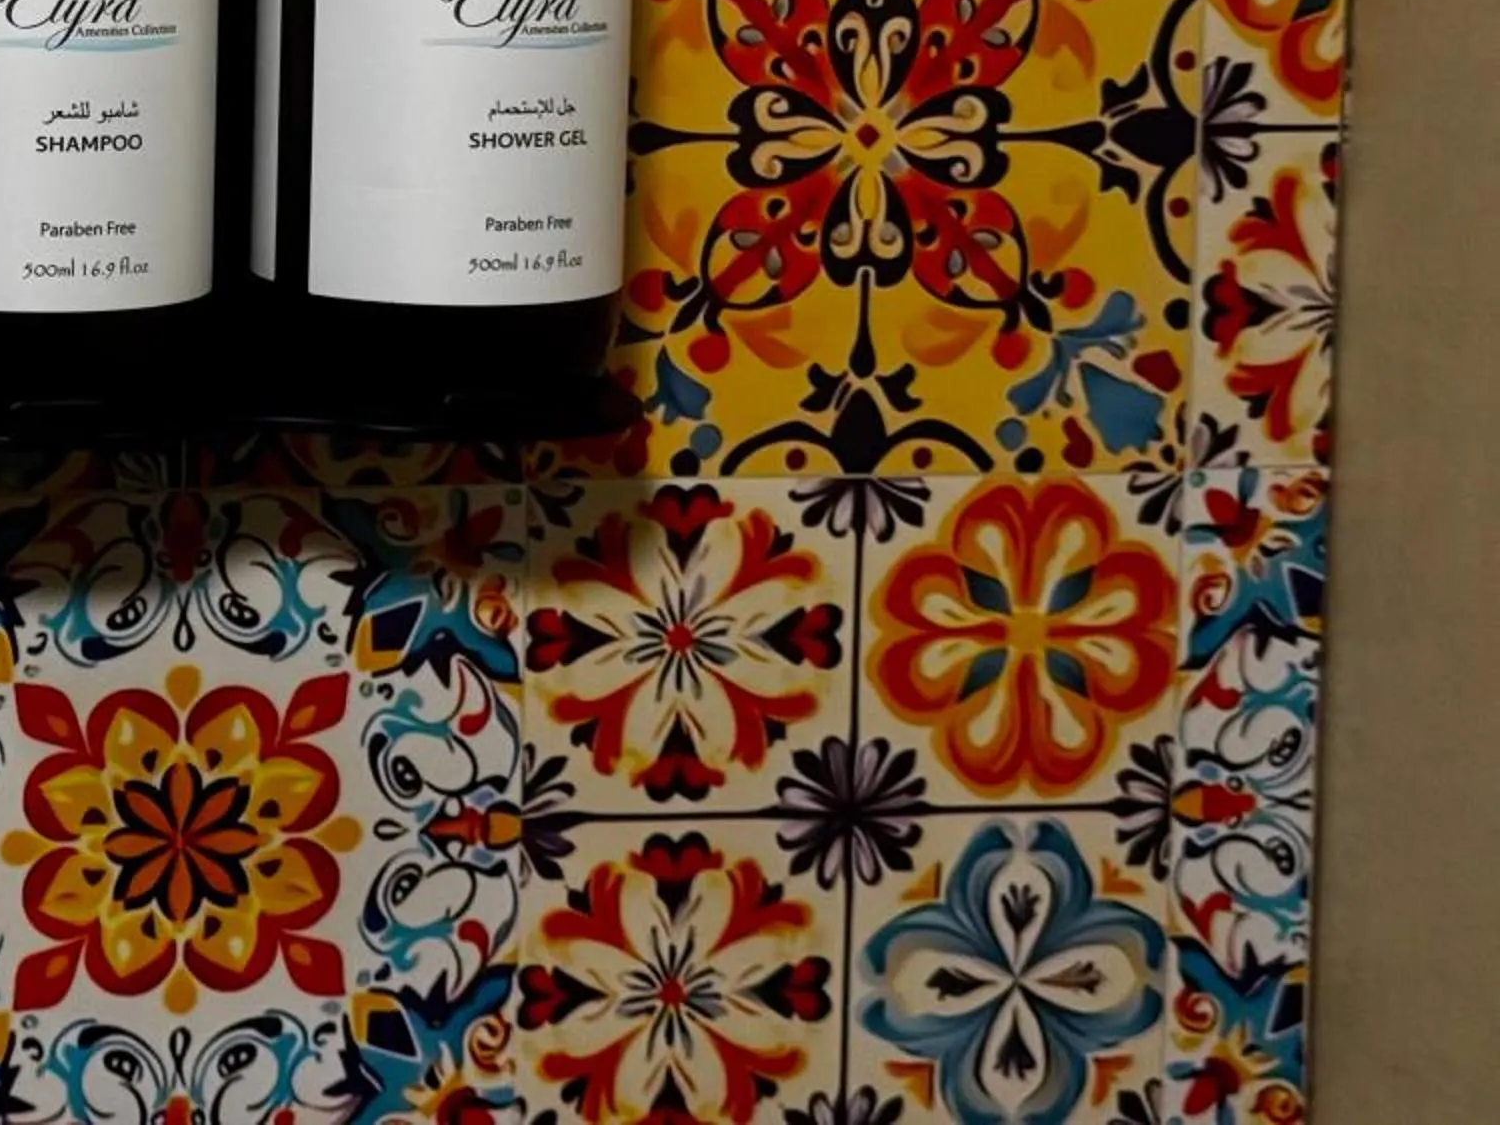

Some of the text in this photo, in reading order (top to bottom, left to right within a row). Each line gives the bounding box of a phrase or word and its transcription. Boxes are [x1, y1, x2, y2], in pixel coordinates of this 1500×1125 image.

[41, 100, 140, 125] شامبو للشعر
[35, 134, 143, 152] SHAMPOO
[468, 129, 587, 149] SHOWER GEL
[39, 221, 137, 237] Paraben Free
[484, 216, 573, 232] Paraben Free
[21, 257, 75, 280] 500ml
[467, 252, 518, 274] 500ml
